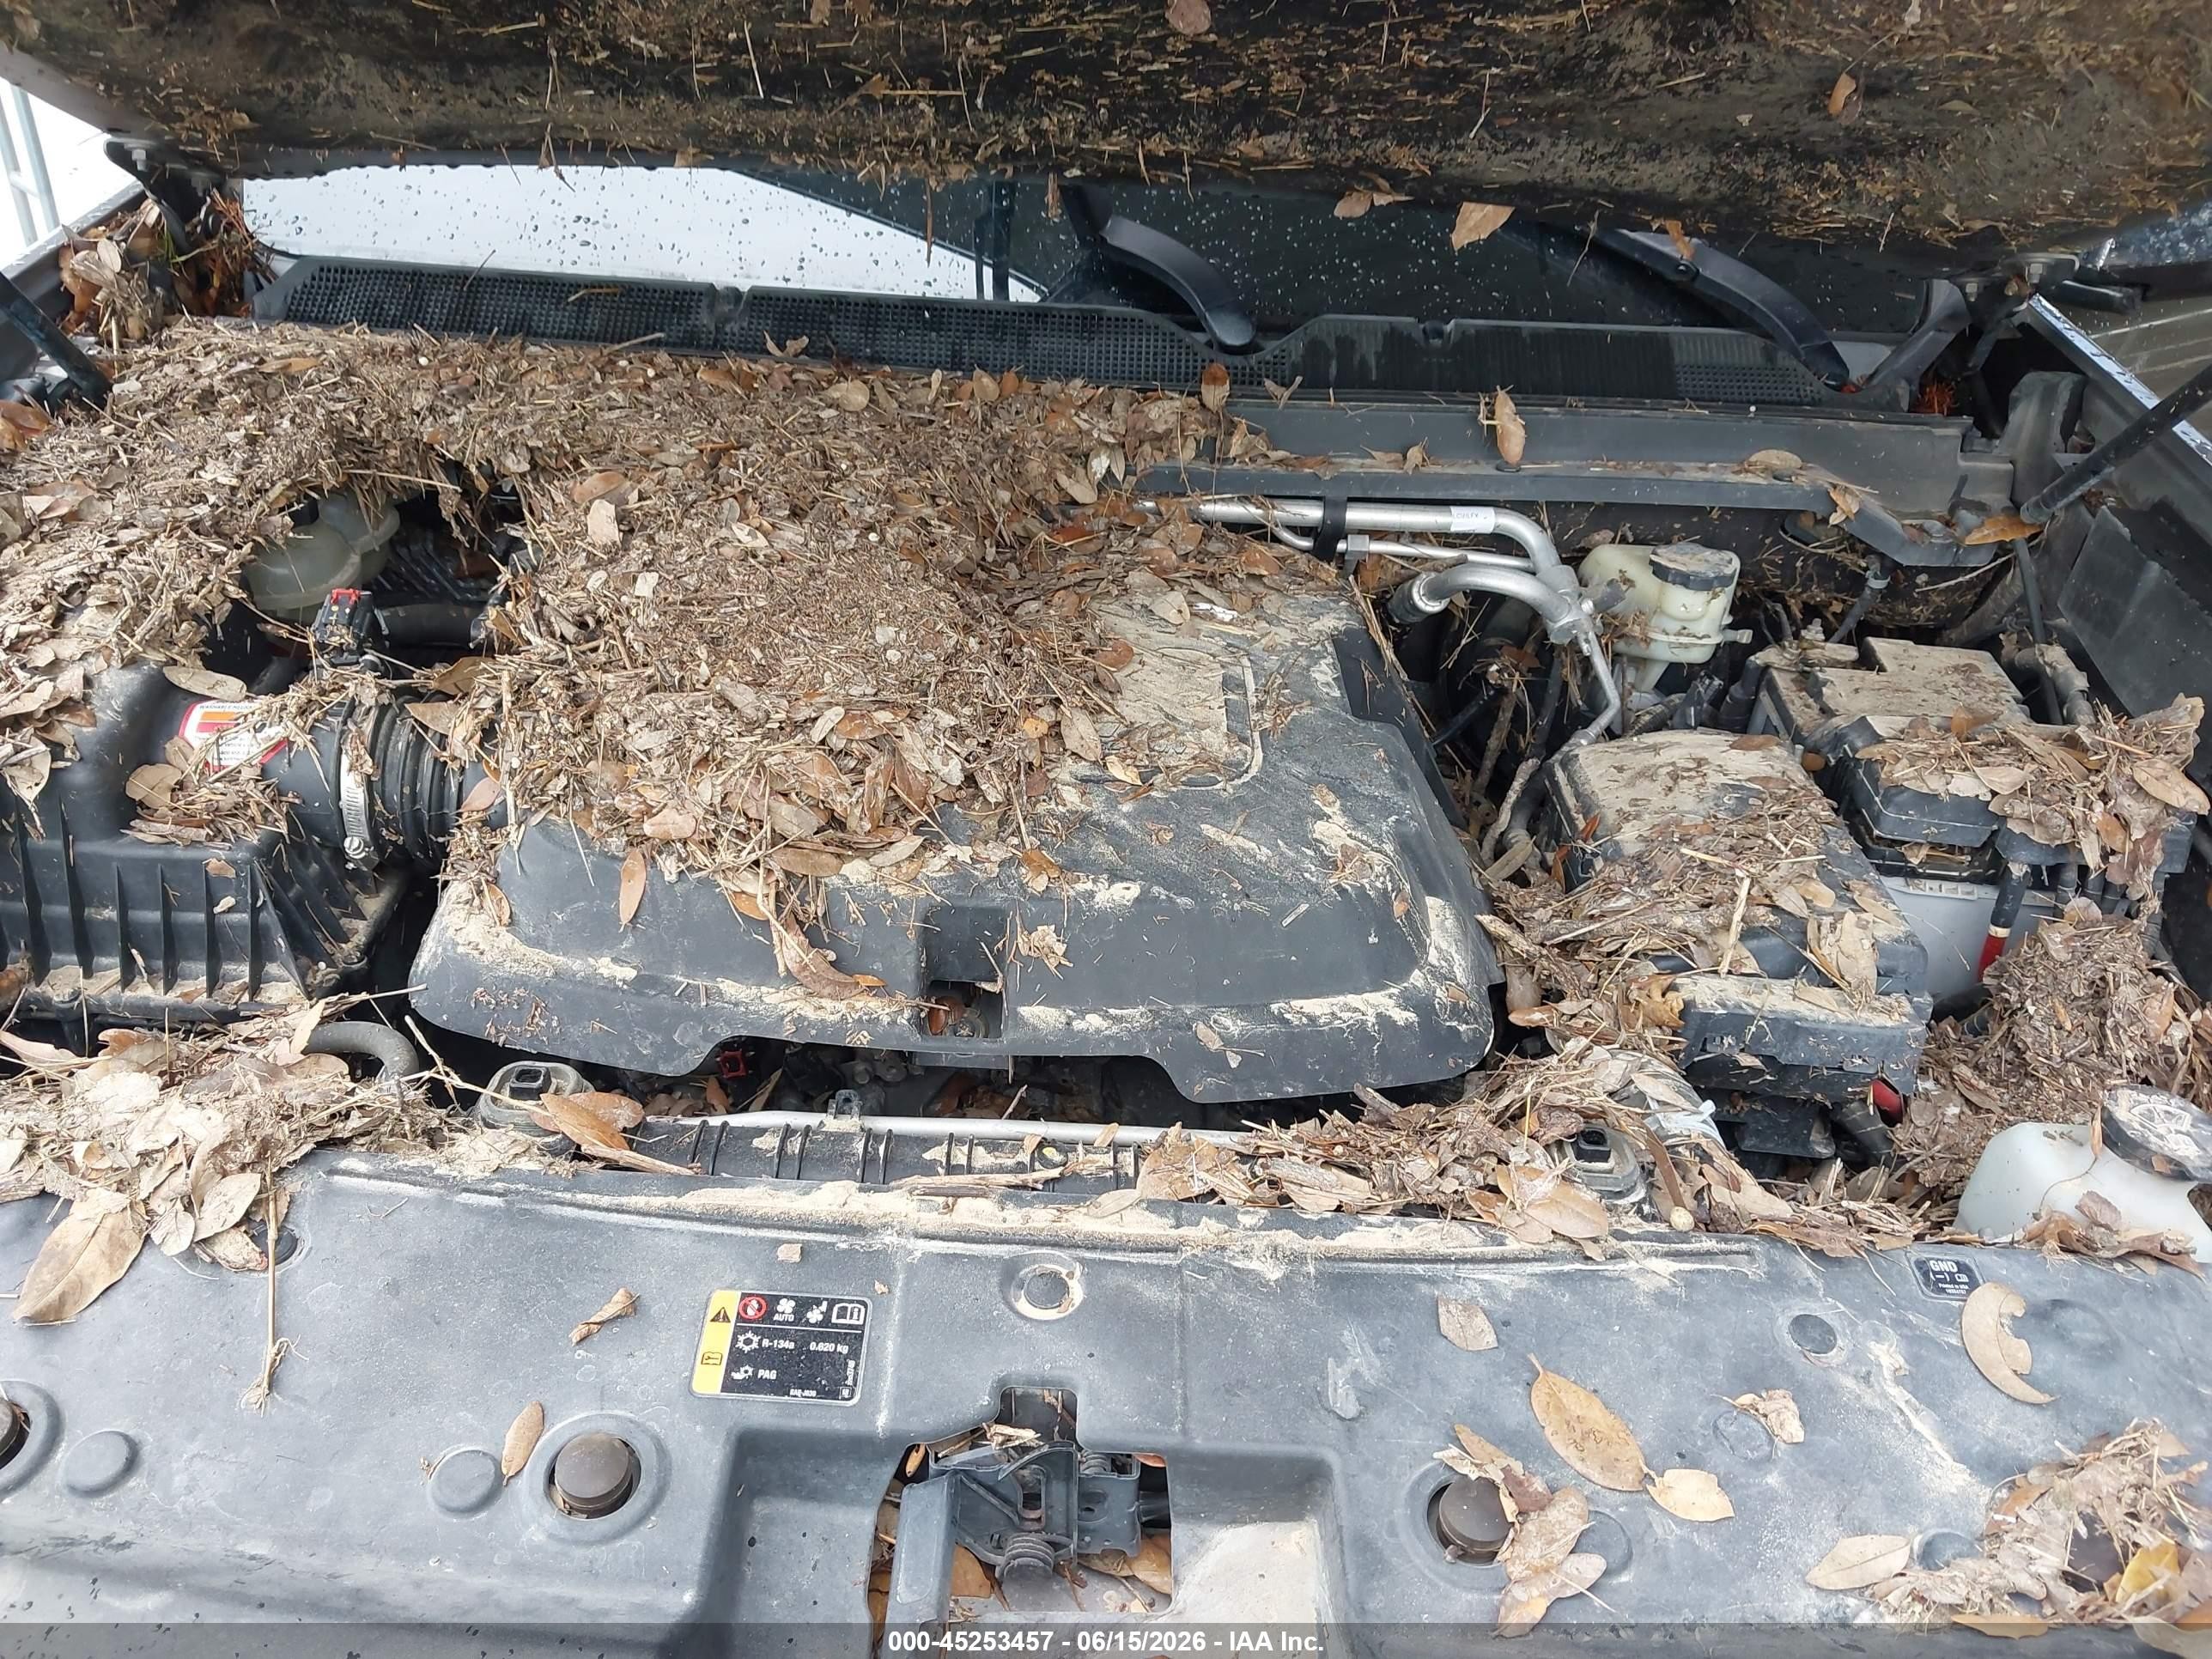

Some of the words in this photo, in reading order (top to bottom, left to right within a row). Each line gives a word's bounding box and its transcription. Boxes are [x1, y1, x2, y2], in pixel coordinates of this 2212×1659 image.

[1929, 1260, 1959, 1273] GND
[773, 1313, 795, 1322] AUTO
[762, 1338, 795, 1349] R-134a
[809, 1341, 835, 1352] 0.620
[836, 1343, 849, 1354] kg
[757, 1369, 777, 1380] PAG
